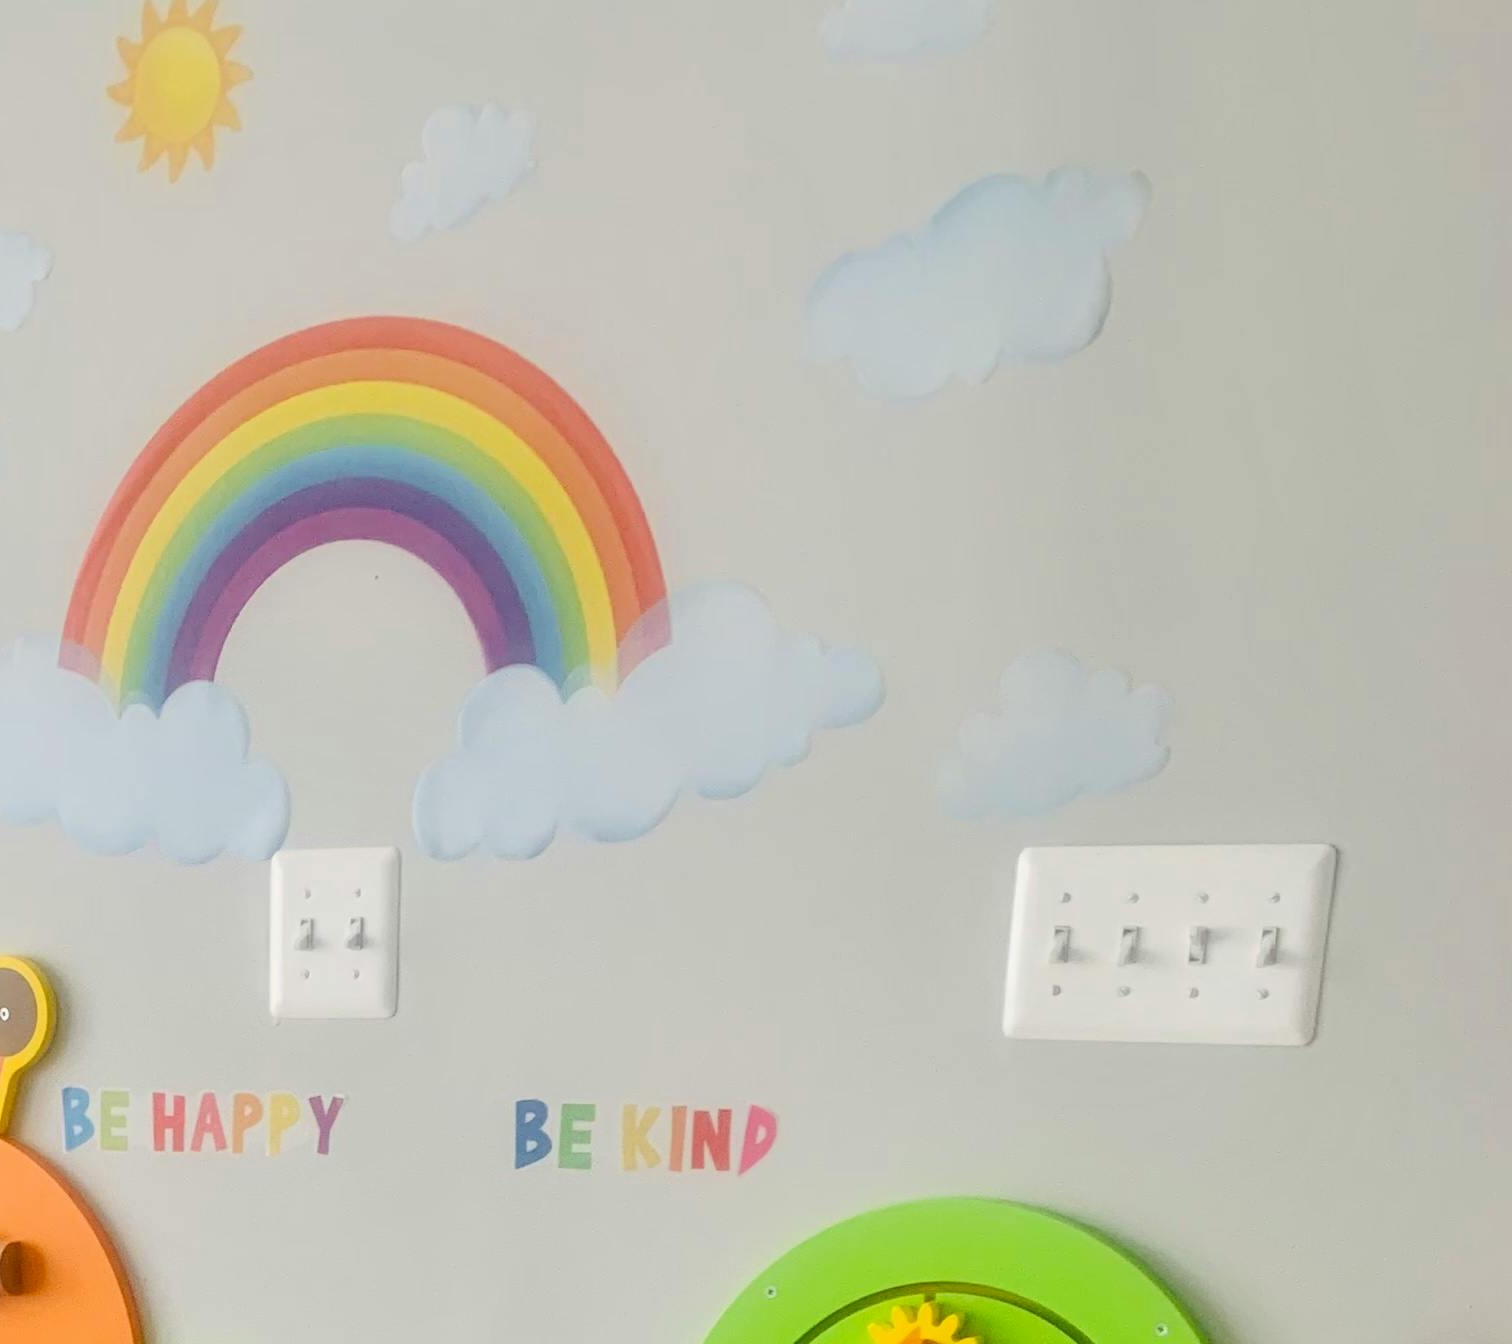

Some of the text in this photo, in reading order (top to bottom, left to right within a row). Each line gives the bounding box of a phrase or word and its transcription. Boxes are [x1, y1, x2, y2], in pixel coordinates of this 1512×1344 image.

[61, 1086, 345, 1156] BE HAPPY
[515, 1099, 778, 1176] BE KIND
